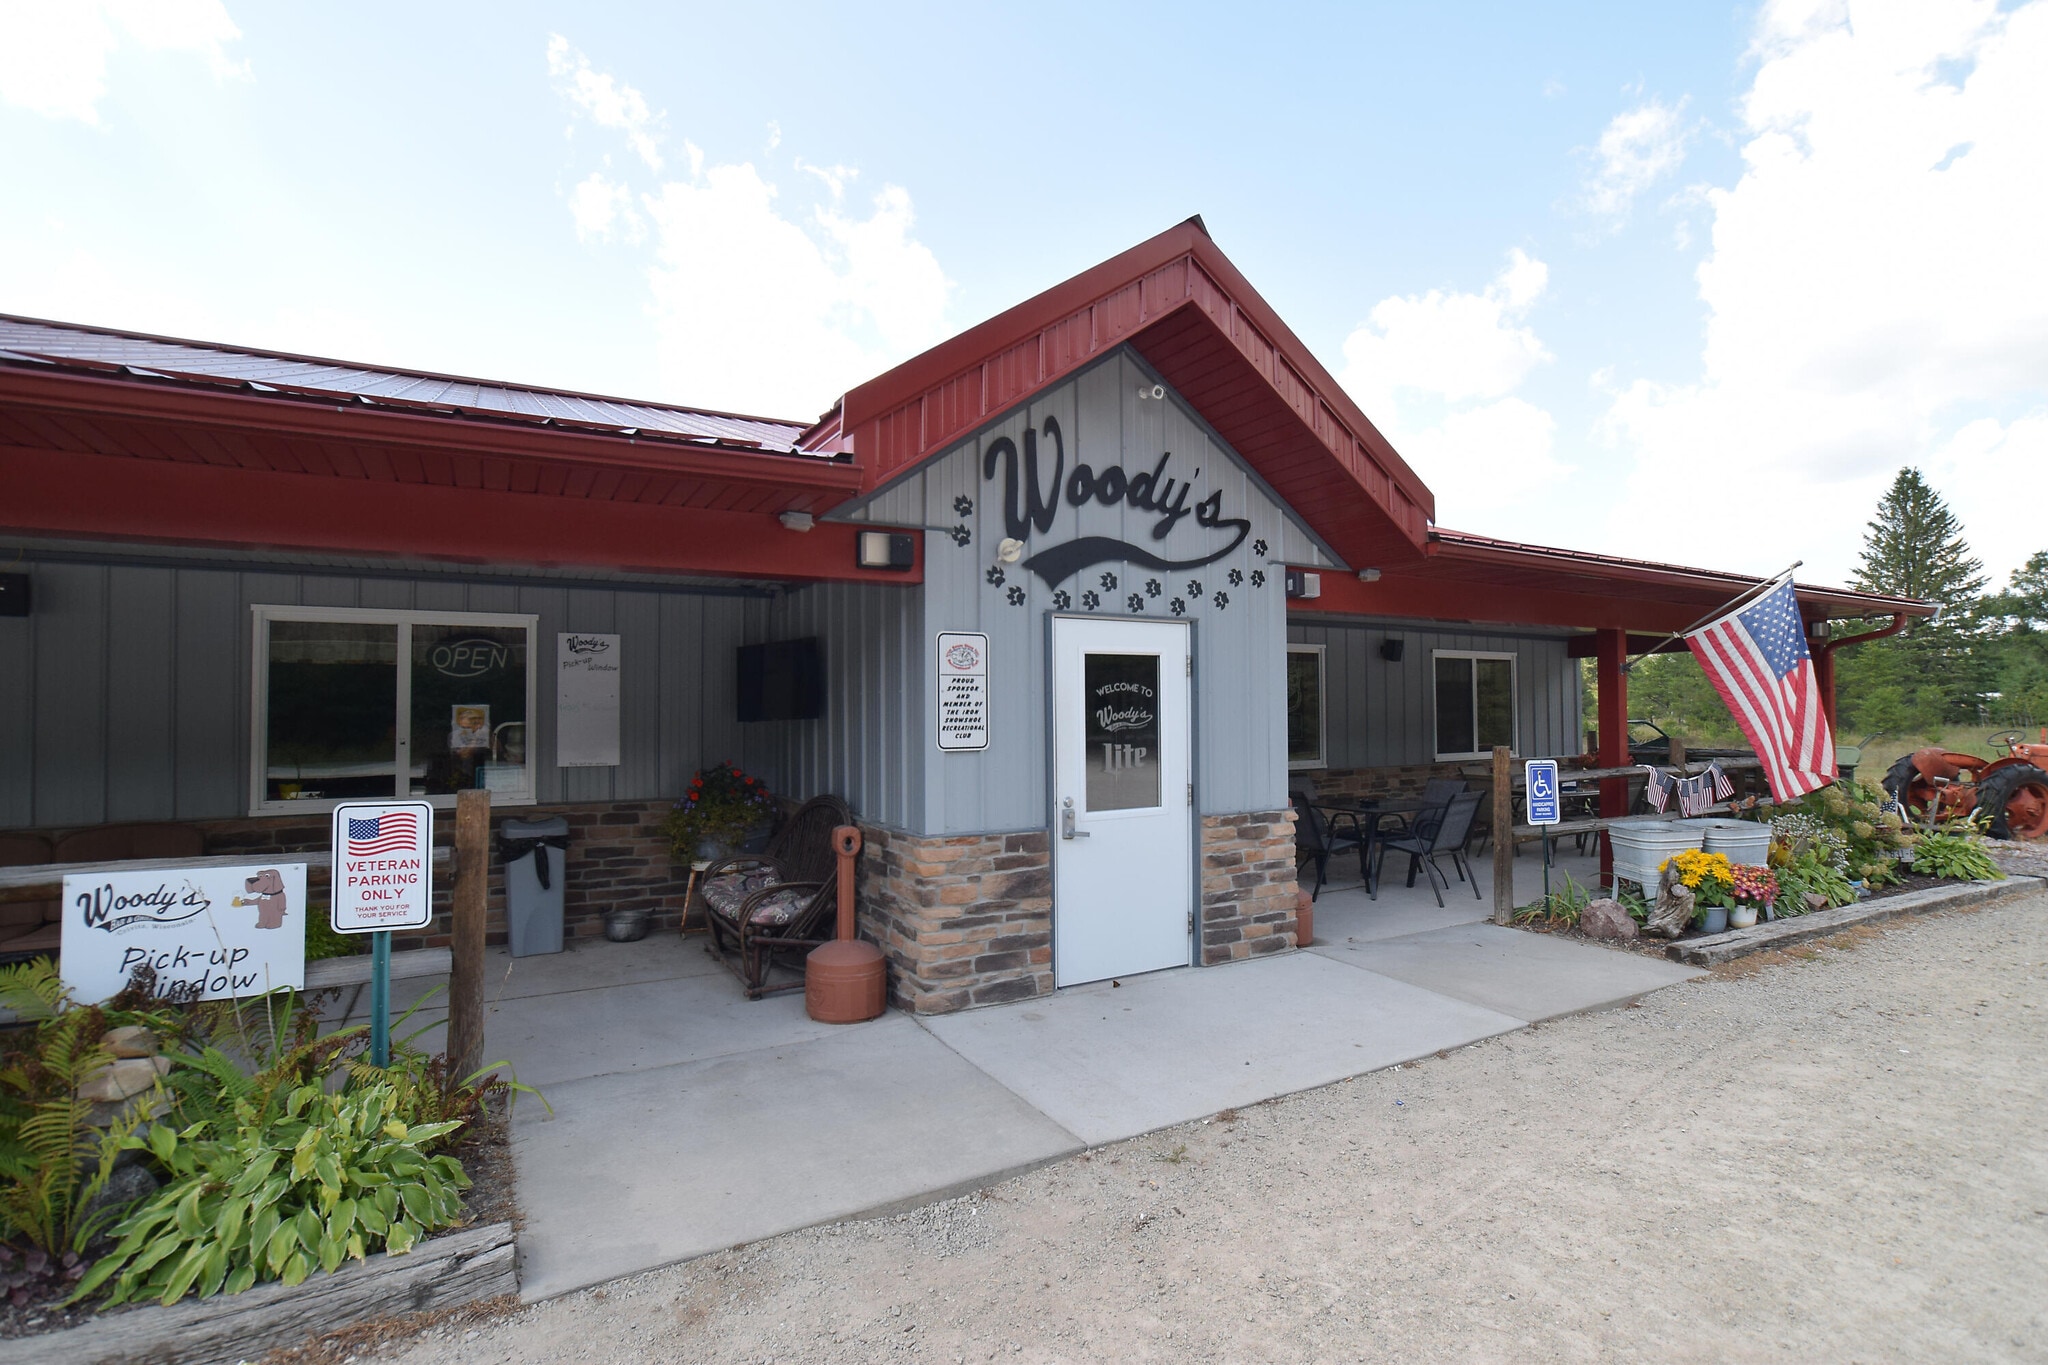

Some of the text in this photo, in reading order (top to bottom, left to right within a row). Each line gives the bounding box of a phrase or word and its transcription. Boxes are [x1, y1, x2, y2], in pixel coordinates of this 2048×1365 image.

[984, 415, 1251, 543] Woody's
[566, 635, 610, 652] Woody's
[432, 646, 508, 668] OPEN
[1096, 682, 1153, 698] WELCOME TO
[1096, 704, 1153, 728] Woody's
[346, 859, 420, 872] VETERAN
[348, 873, 418, 887] PARKING
[361, 888, 405, 900] ONLY
[76, 883, 212, 928] Woody's
[378, 910, 407, 918] SERVICE
[119, 945, 249, 973] Pick-up
